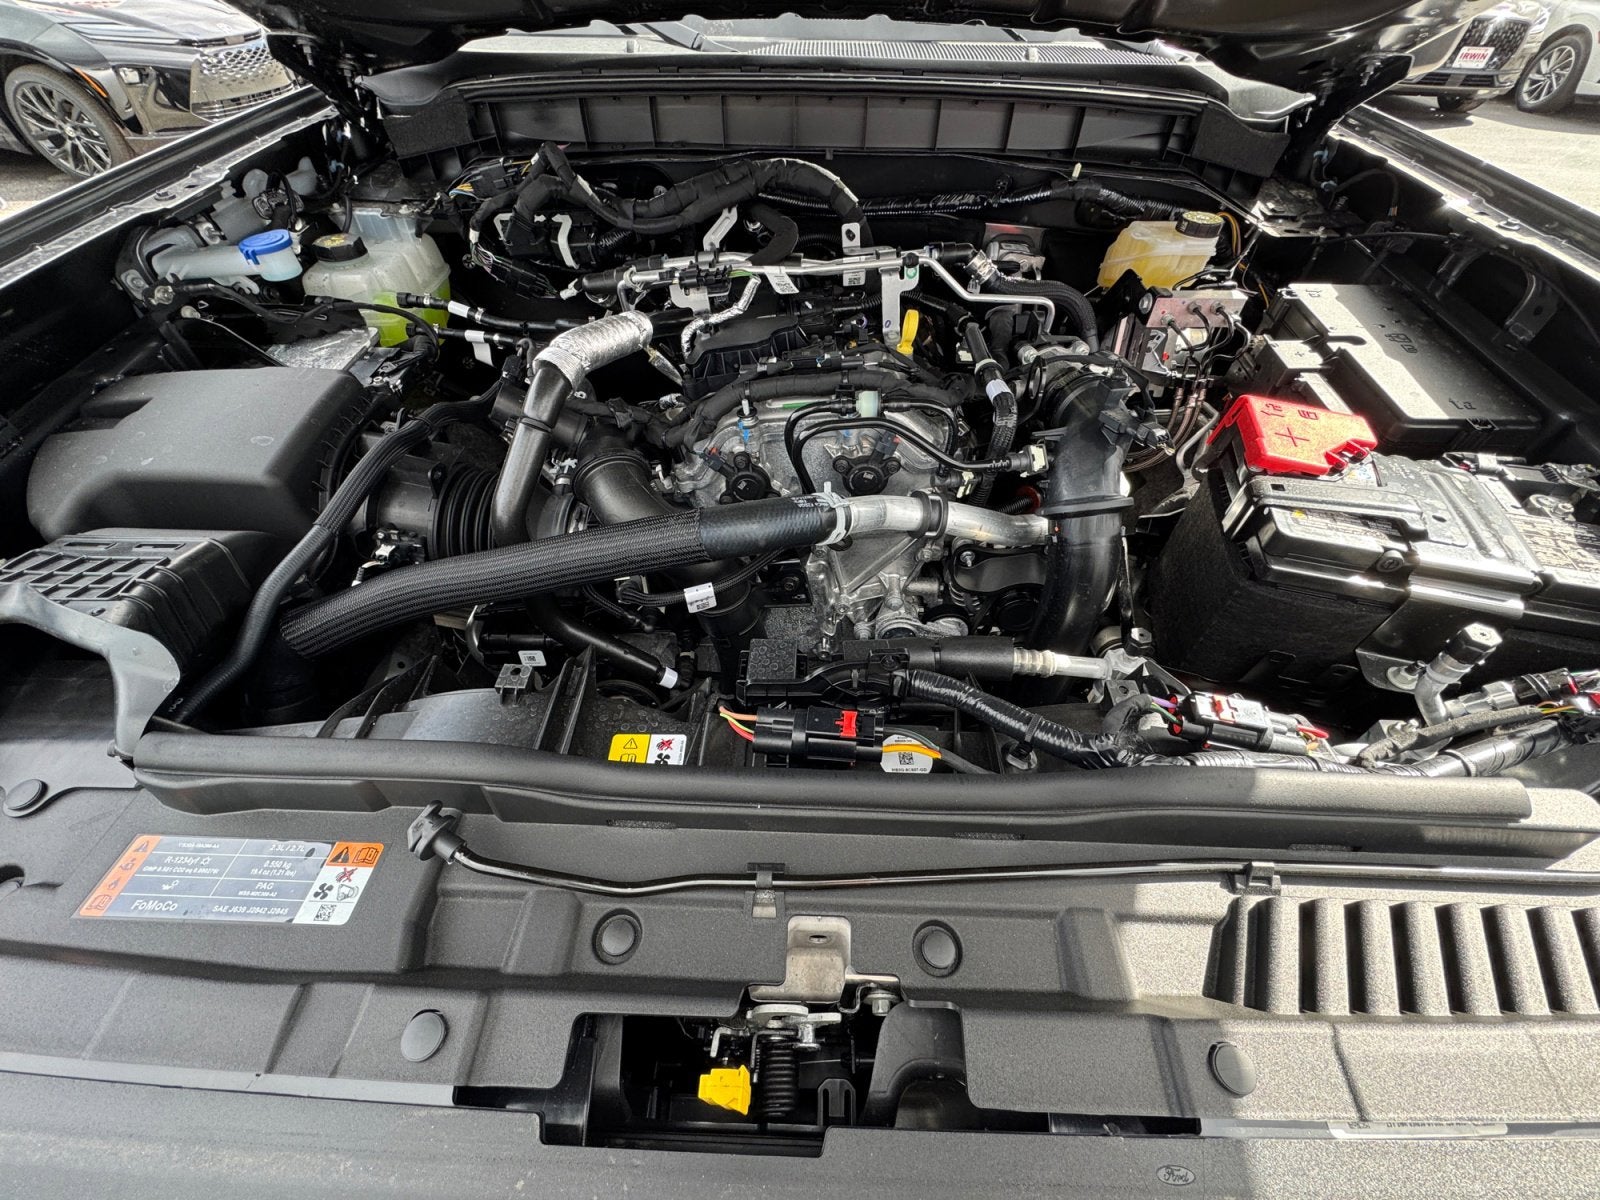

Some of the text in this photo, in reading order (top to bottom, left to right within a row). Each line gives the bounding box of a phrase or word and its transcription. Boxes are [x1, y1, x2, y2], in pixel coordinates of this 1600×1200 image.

[1459, 52, 1488, 60] IRWIN
[164, 855, 201, 866] R-1234yf
[283, 861, 292, 870] kg
[255, 882, 275, 890] PAG
[130, 899, 178, 911] FoMoCo
[212, 905, 229, 913] SAE
[1163, 1166, 1189, 1182] Ford
